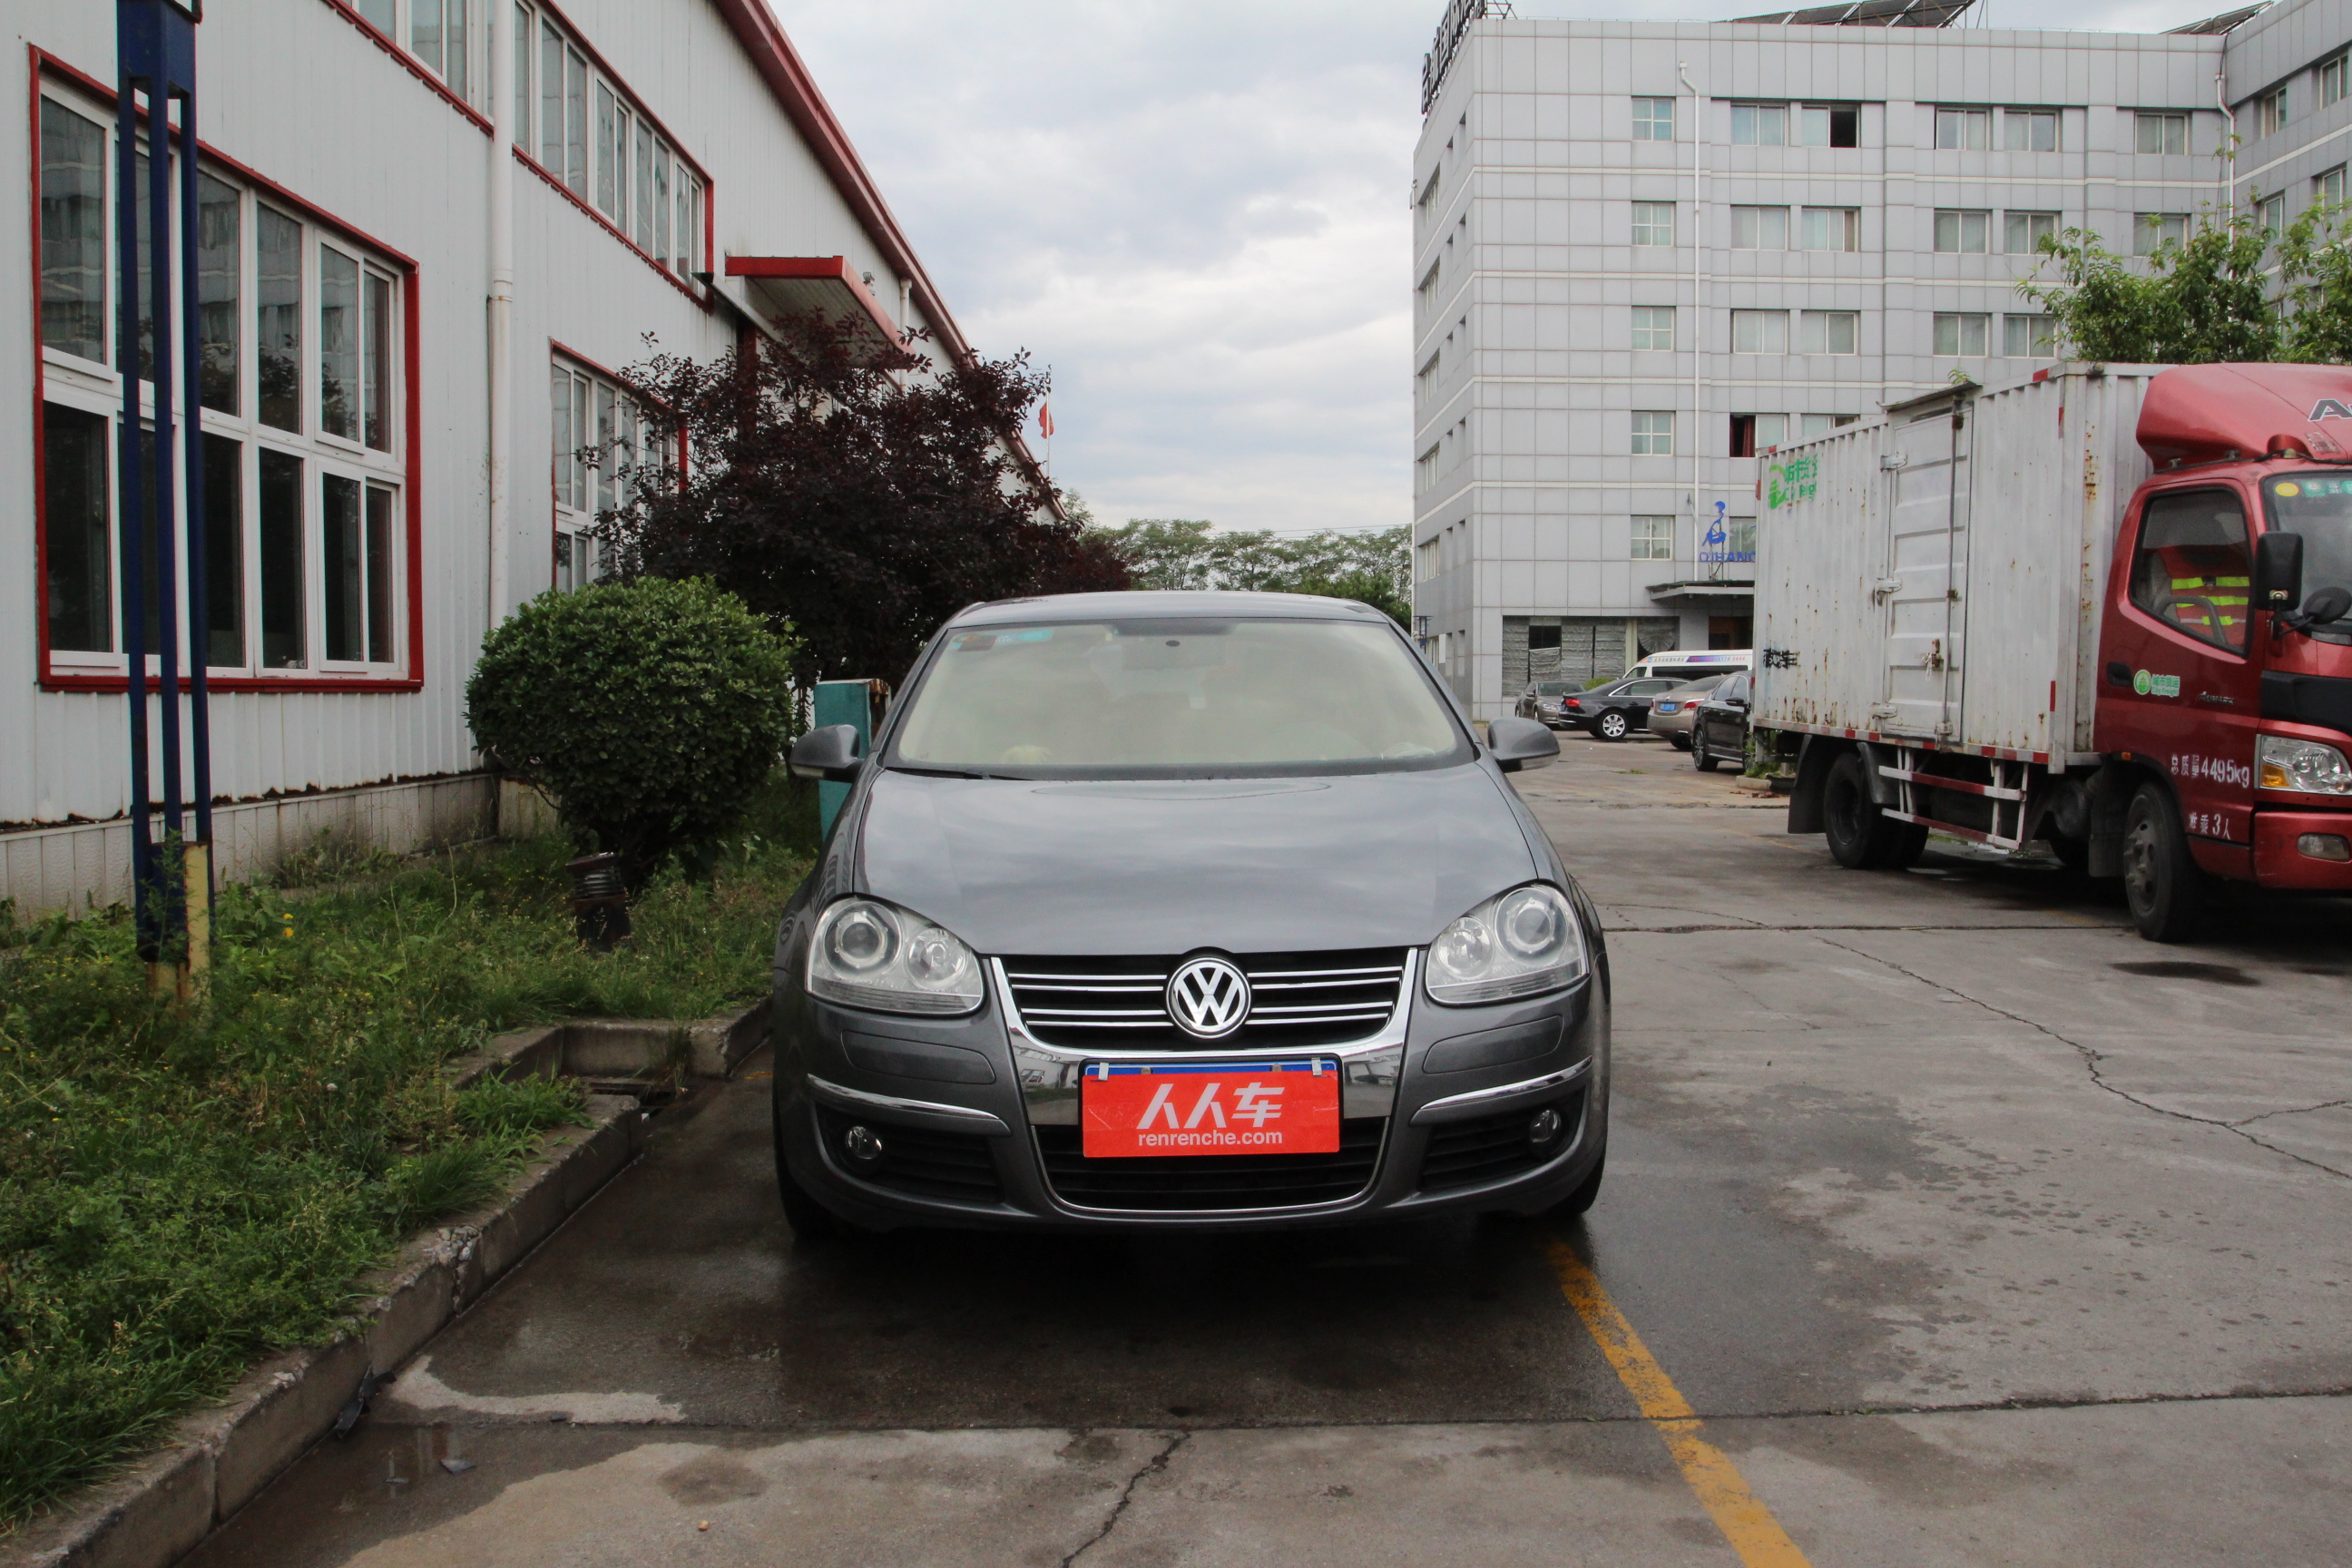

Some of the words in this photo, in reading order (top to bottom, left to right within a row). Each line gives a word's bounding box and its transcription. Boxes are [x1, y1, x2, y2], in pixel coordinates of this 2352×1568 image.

[1136, 1082, 1285, 1130] 人人车
[1138, 1130, 1283, 1146] renrenche.com
